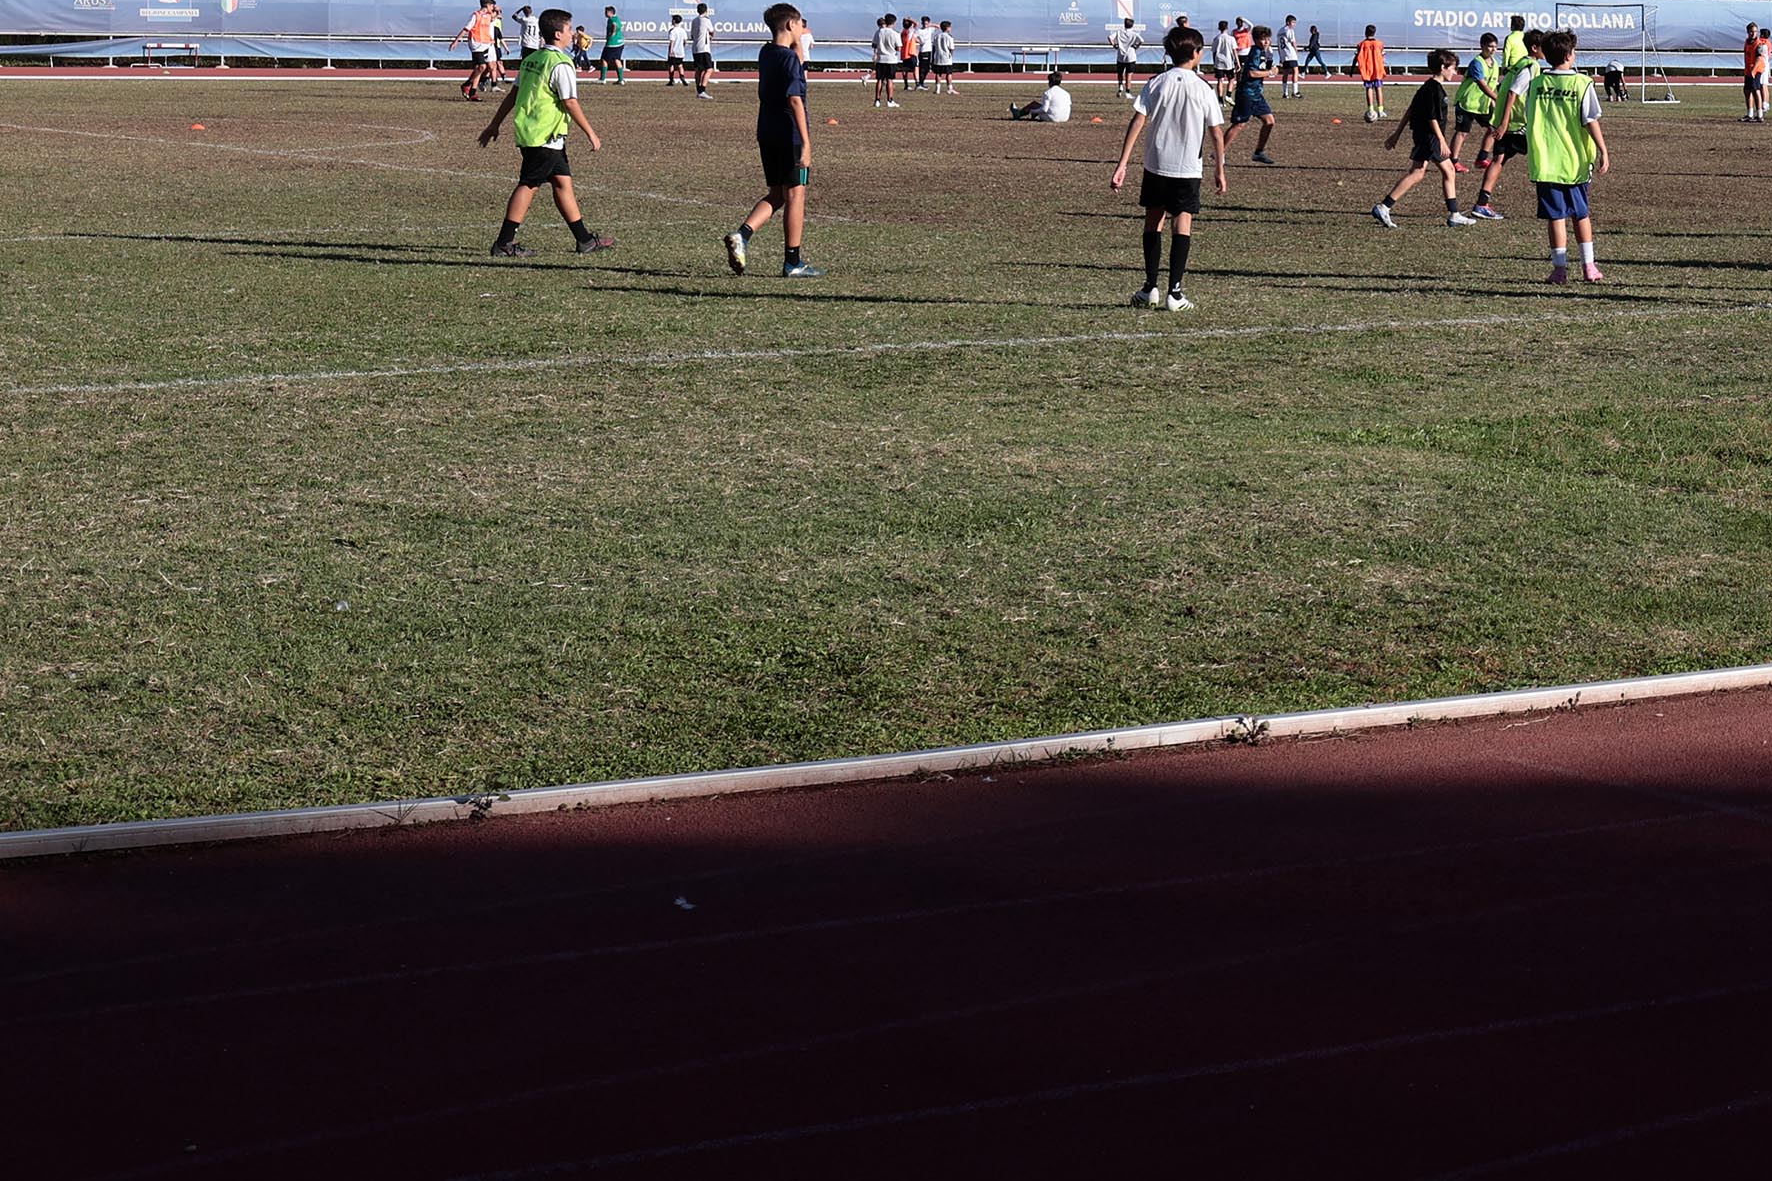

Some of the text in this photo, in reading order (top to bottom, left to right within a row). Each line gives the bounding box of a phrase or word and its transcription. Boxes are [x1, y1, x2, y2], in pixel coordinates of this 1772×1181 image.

[620, 21, 657, 32] TADIO
[714, 22, 771, 33] COLLANA
[1414, 9, 1478, 27] STADIO
[1557, 12, 1635, 29] COLLANA
